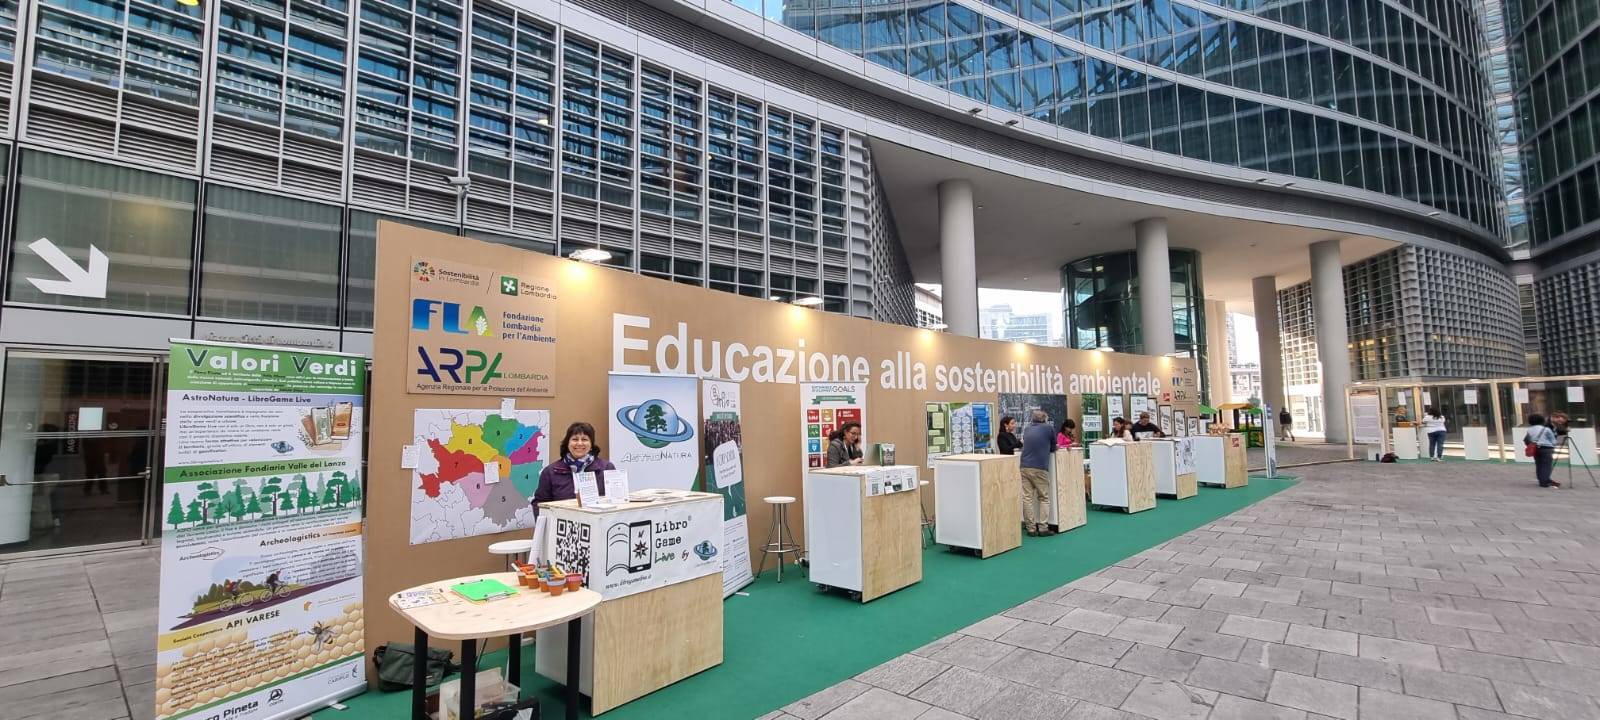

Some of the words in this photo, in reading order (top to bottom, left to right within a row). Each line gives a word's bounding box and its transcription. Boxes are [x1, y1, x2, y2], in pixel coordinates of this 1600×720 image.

[438, 268, 480, 281] Sostenibilità
[520, 281, 550, 292] Regione
[520, 288, 557, 300] Lombardia
[412, 298, 494, 337] FLA
[503, 311, 544, 323] Fondazione
[503, 322, 541, 332] Lombardia
[502, 332, 515, 341] per
[517, 332, 556, 344] l'Ambiente
[613, 312, 870, 387] Educazione
[880, 350, 927, 391] alla
[935, 358, 1064, 394] sostenibilità
[1069, 369, 1161, 396] ambientale
[187, 348, 279, 373] Valori
[291, 355, 356, 377] Verdi
[417, 345, 504, 385] ARPA
[503, 373, 549, 381] LOMBARDIA
[416, 382, 442, 391] Agenzia
[442, 384, 471, 392] Regionale
[832, 385, 856, 393] GOALS
[182, 393, 239, 403] AstroNatura
[248, 395, 294, 403] LibroGame
[179, 466, 242, 478] Associazione
[245, 463, 286, 473] Fondiaria
[288, 462, 308, 470] Valle
[324, 460, 346, 468] Lanza
[655, 520, 688, 534] Libro
[260, 532, 321, 547] Archeologistics
[655, 536, 682, 549] Game
[654, 551, 676, 564] Live
[226, 620, 243, 630] API
[246, 609, 280, 624] VARESE
[223, 701, 258, 718] Pineta
